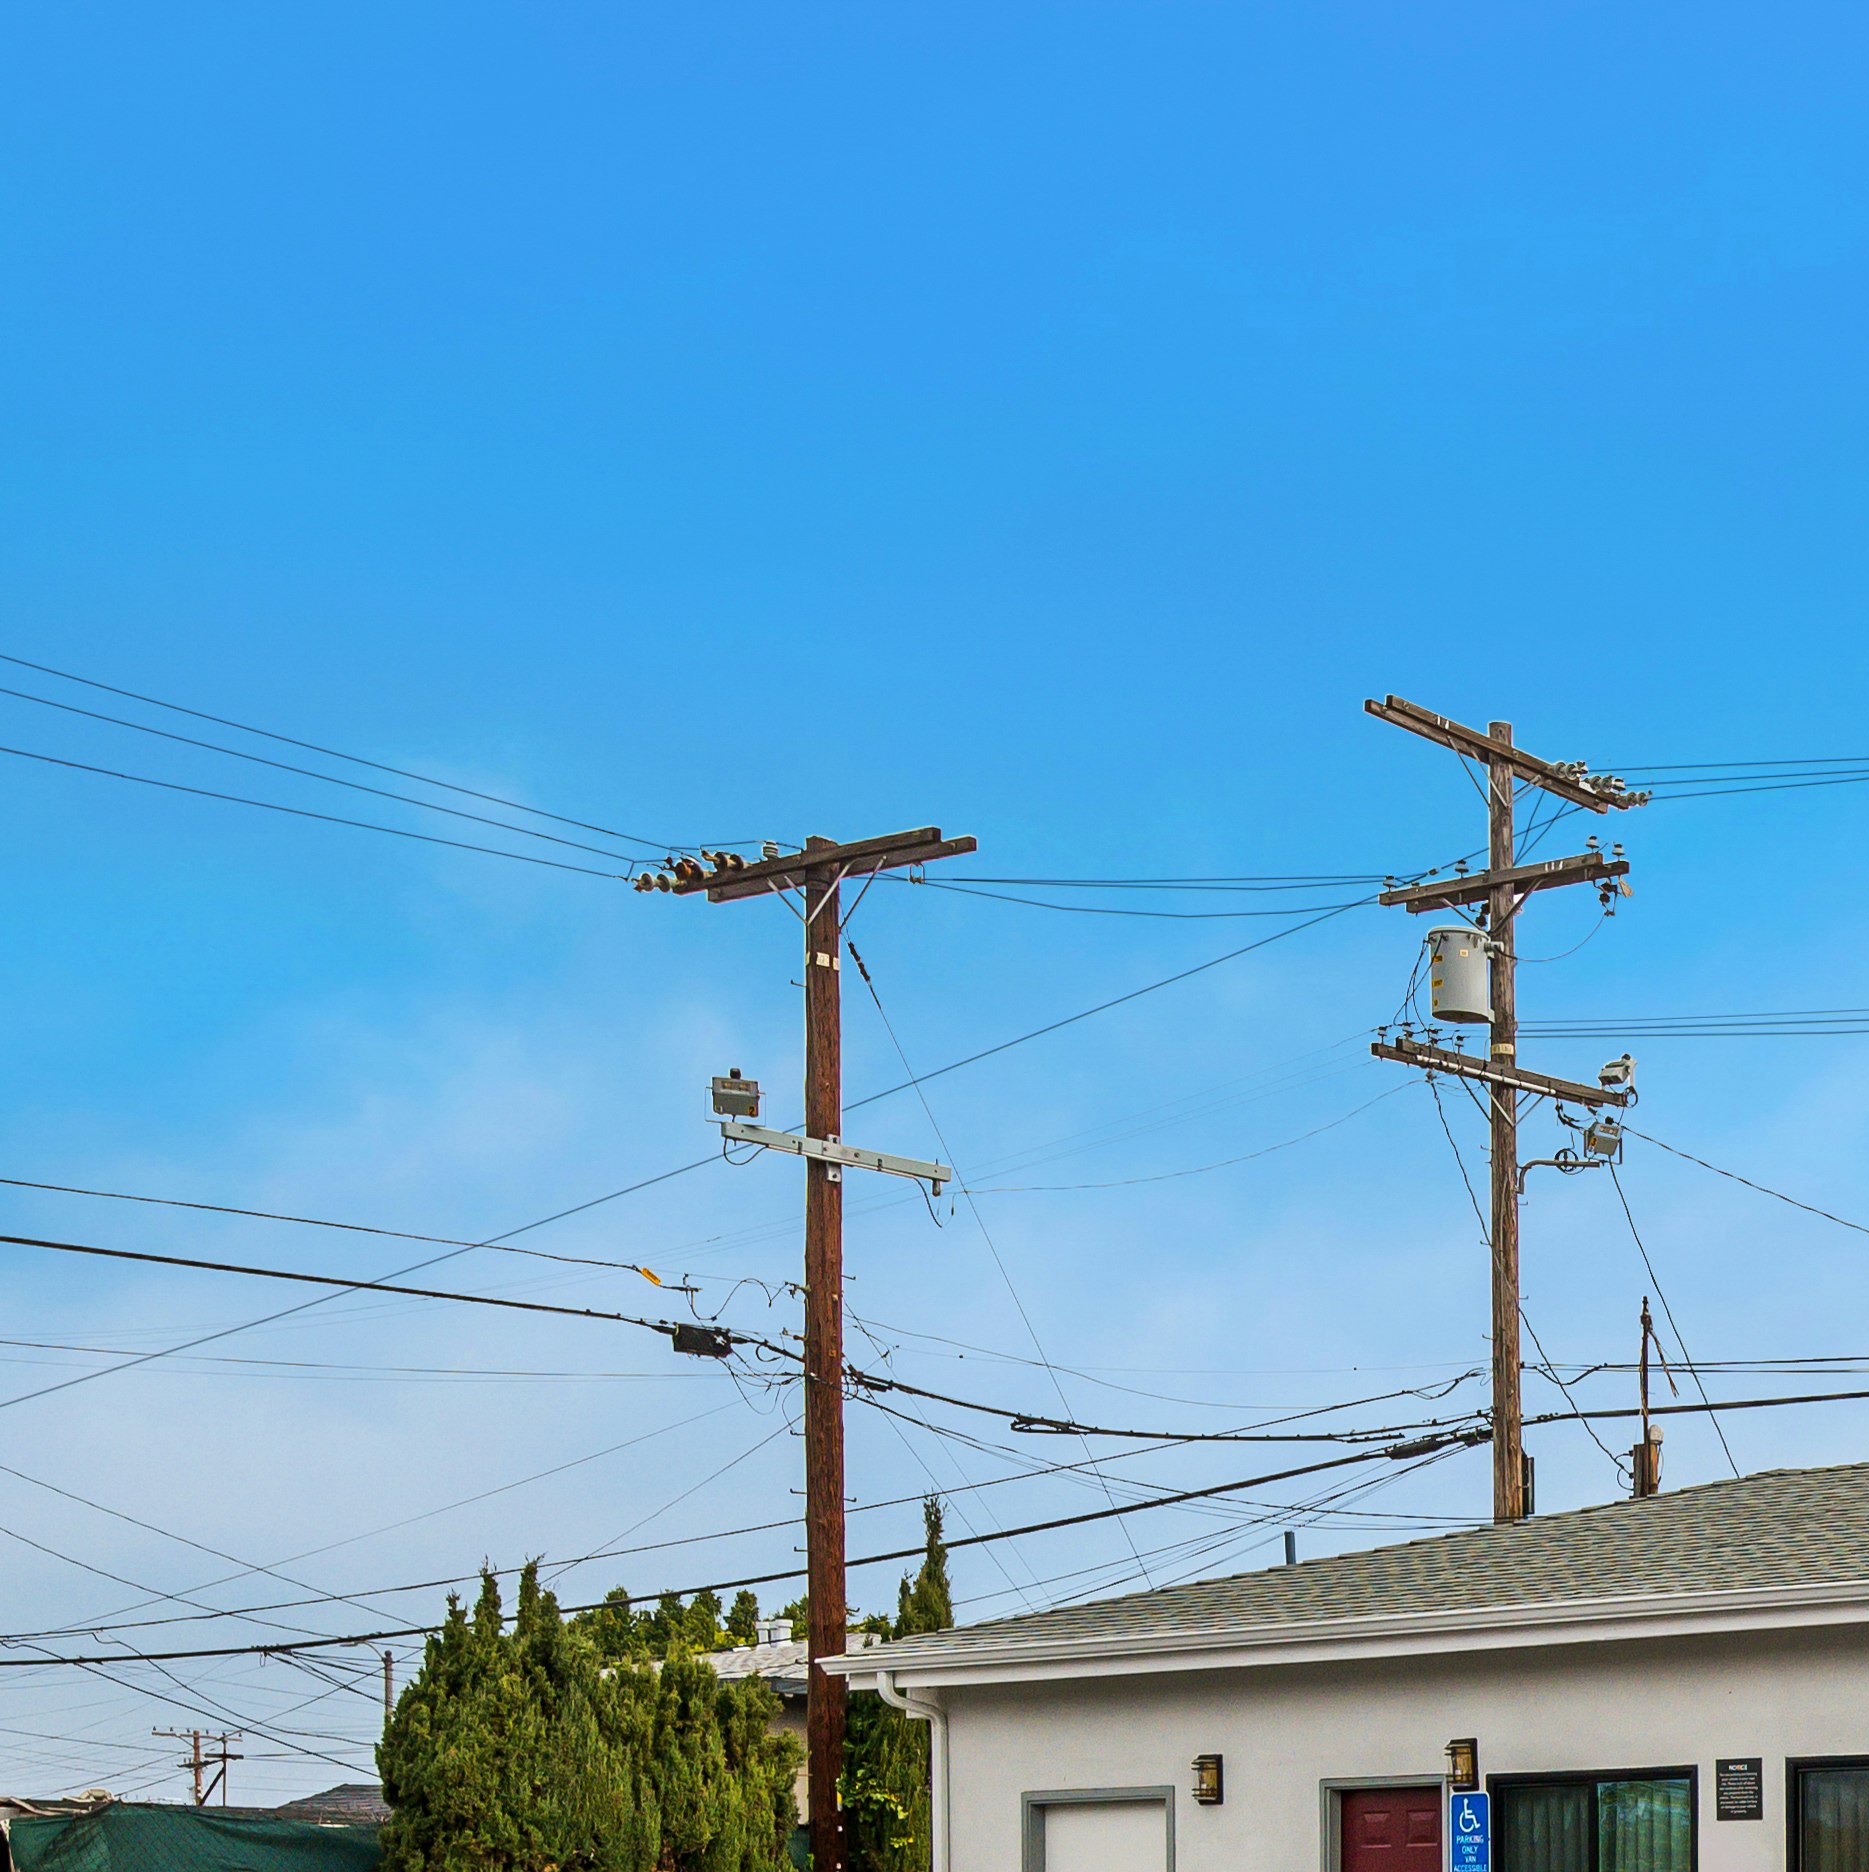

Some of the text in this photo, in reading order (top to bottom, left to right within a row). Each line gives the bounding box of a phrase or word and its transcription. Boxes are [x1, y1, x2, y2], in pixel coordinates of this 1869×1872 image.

[1456, 1835, 1484, 1845] PARKING
[1461, 1845, 1479, 1855] ONLY
[1464, 1855, 1477, 1864] VAN
[1453, 1864, 1487, 1872] ACCESSIBLE
